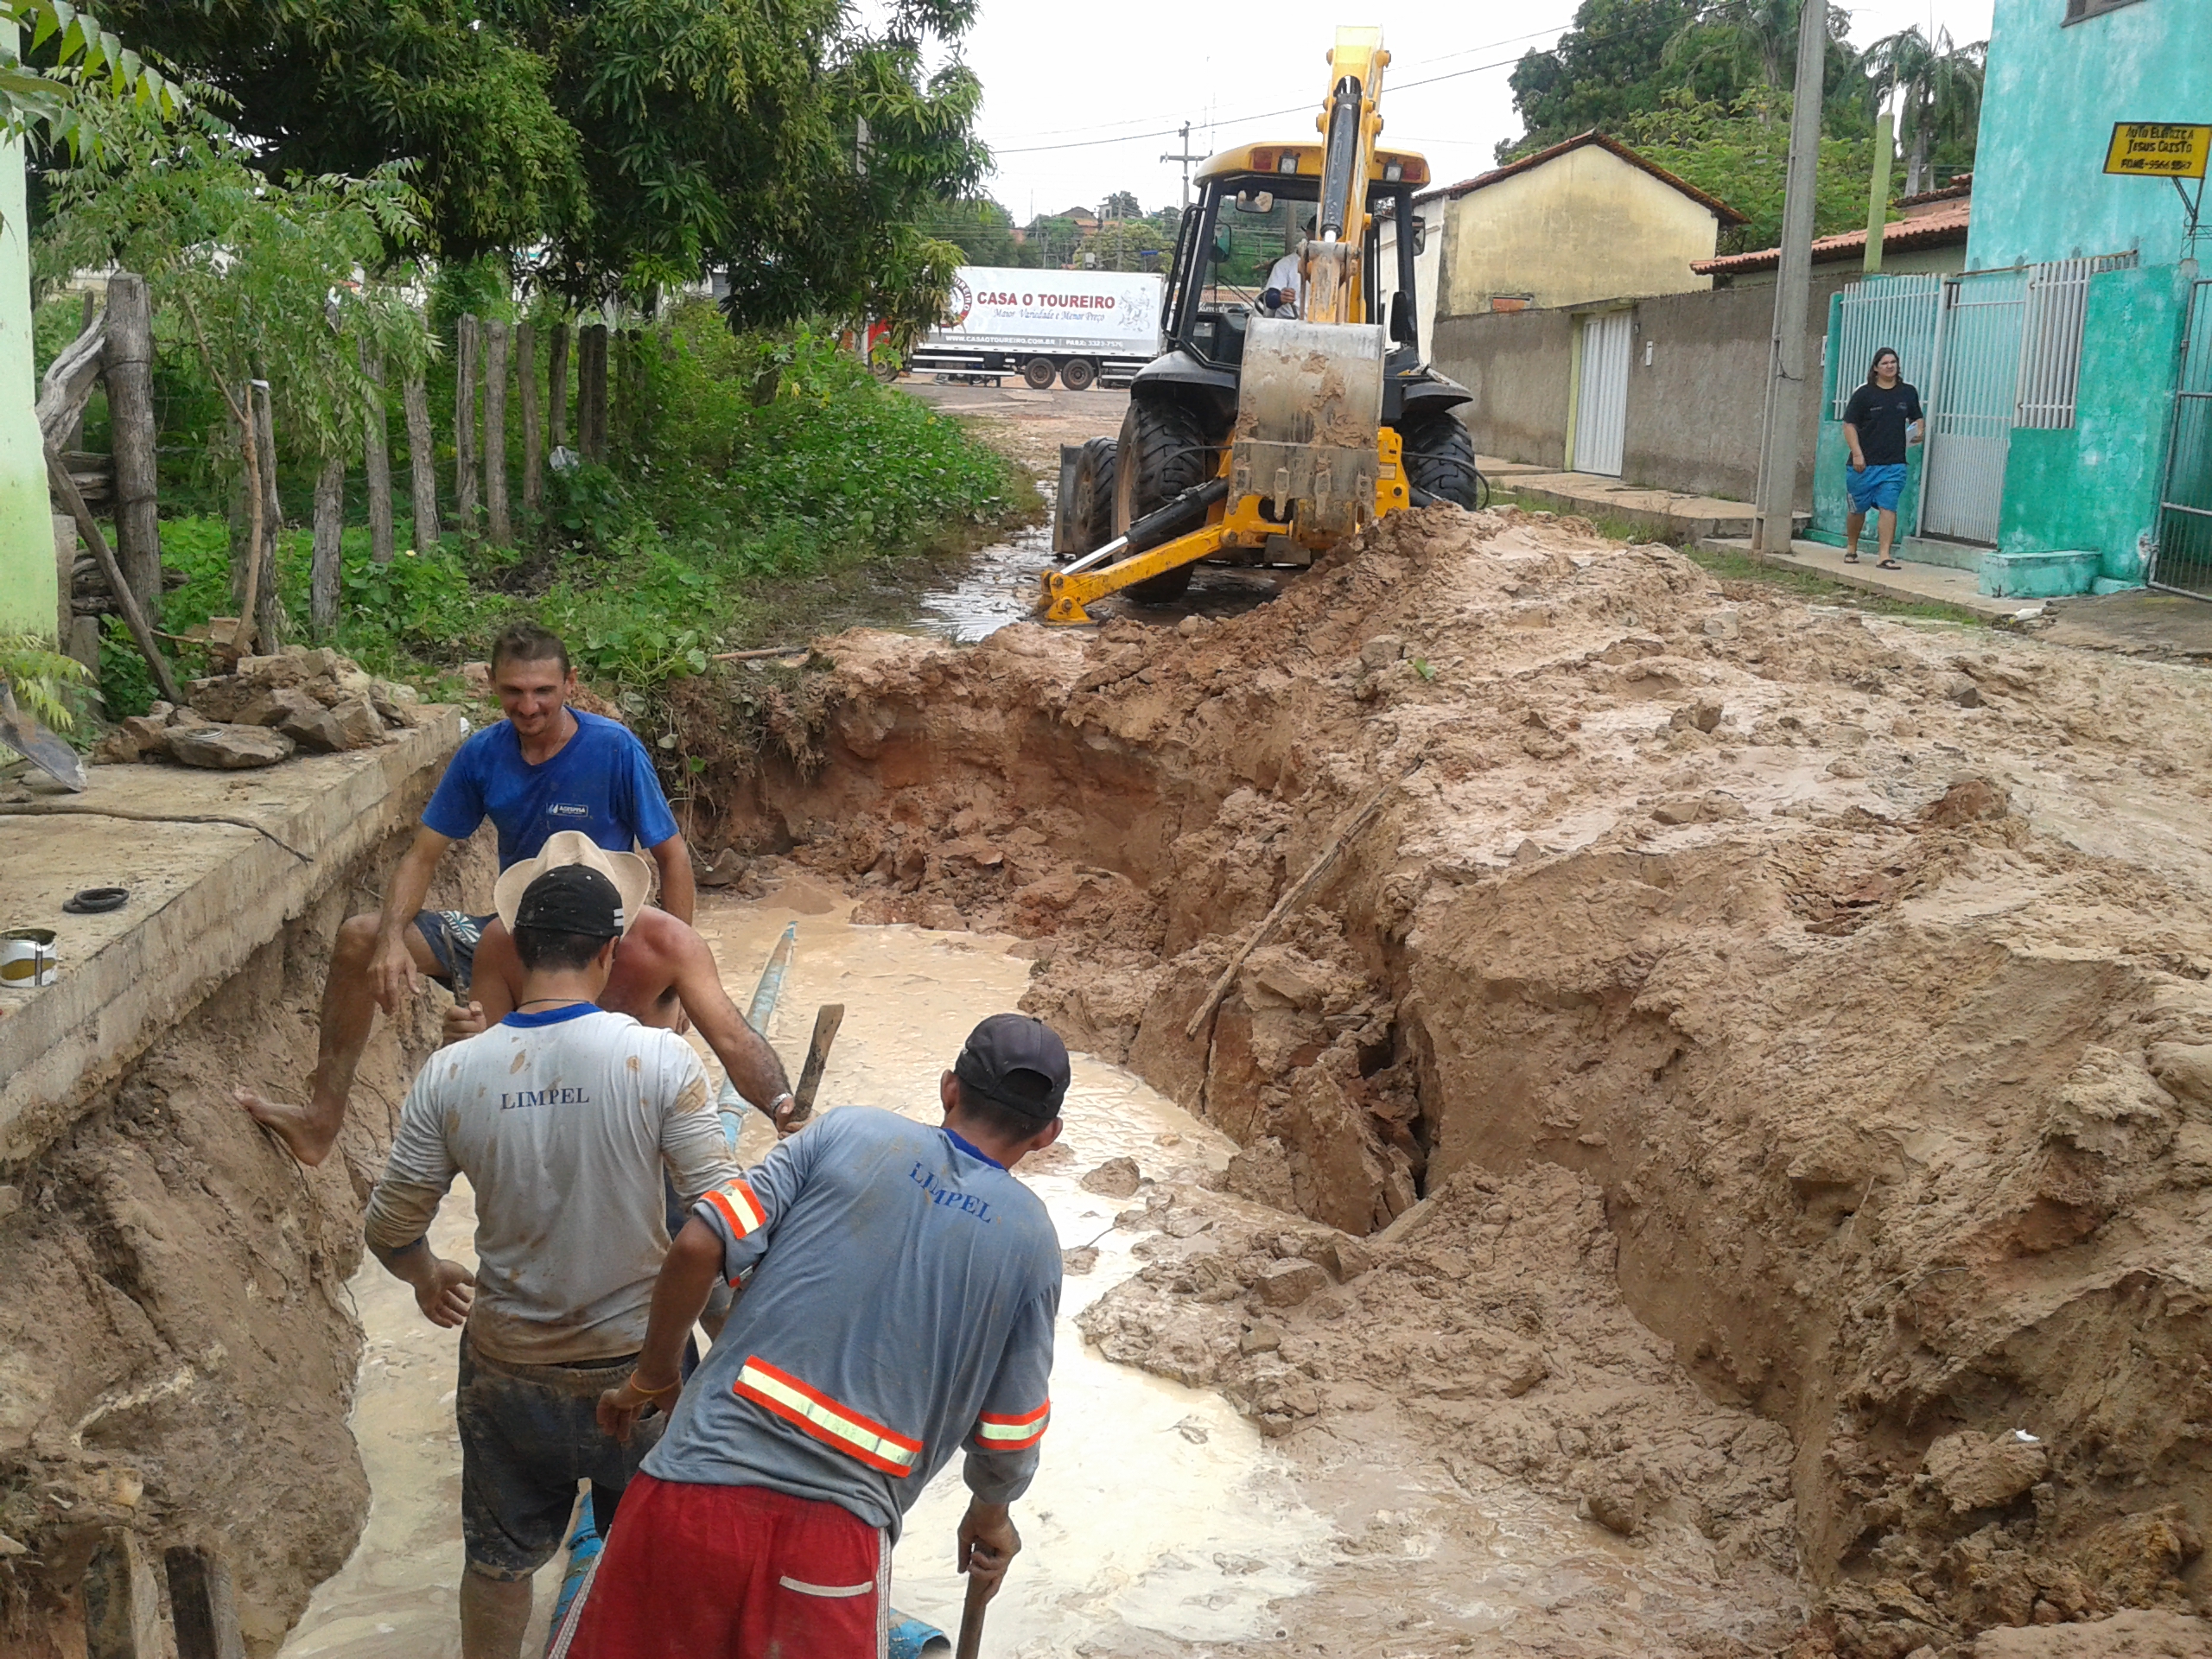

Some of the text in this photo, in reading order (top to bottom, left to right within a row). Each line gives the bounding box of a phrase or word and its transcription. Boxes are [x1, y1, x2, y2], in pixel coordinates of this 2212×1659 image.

[2126, 139, 2192, 154] JESUS CRISTO
[977, 292, 1116, 309] CASA O TOUREIRO
[994, 308, 1015, 318] Maior
[1020, 308, 1053, 320] Variedade
[1061, 311, 1085, 321] Menor
[1085, 312, 1105, 323] Preço
[501, 1088, 589, 1110] LIMPEL
[909, 1161, 991, 1224] LIMPEL
